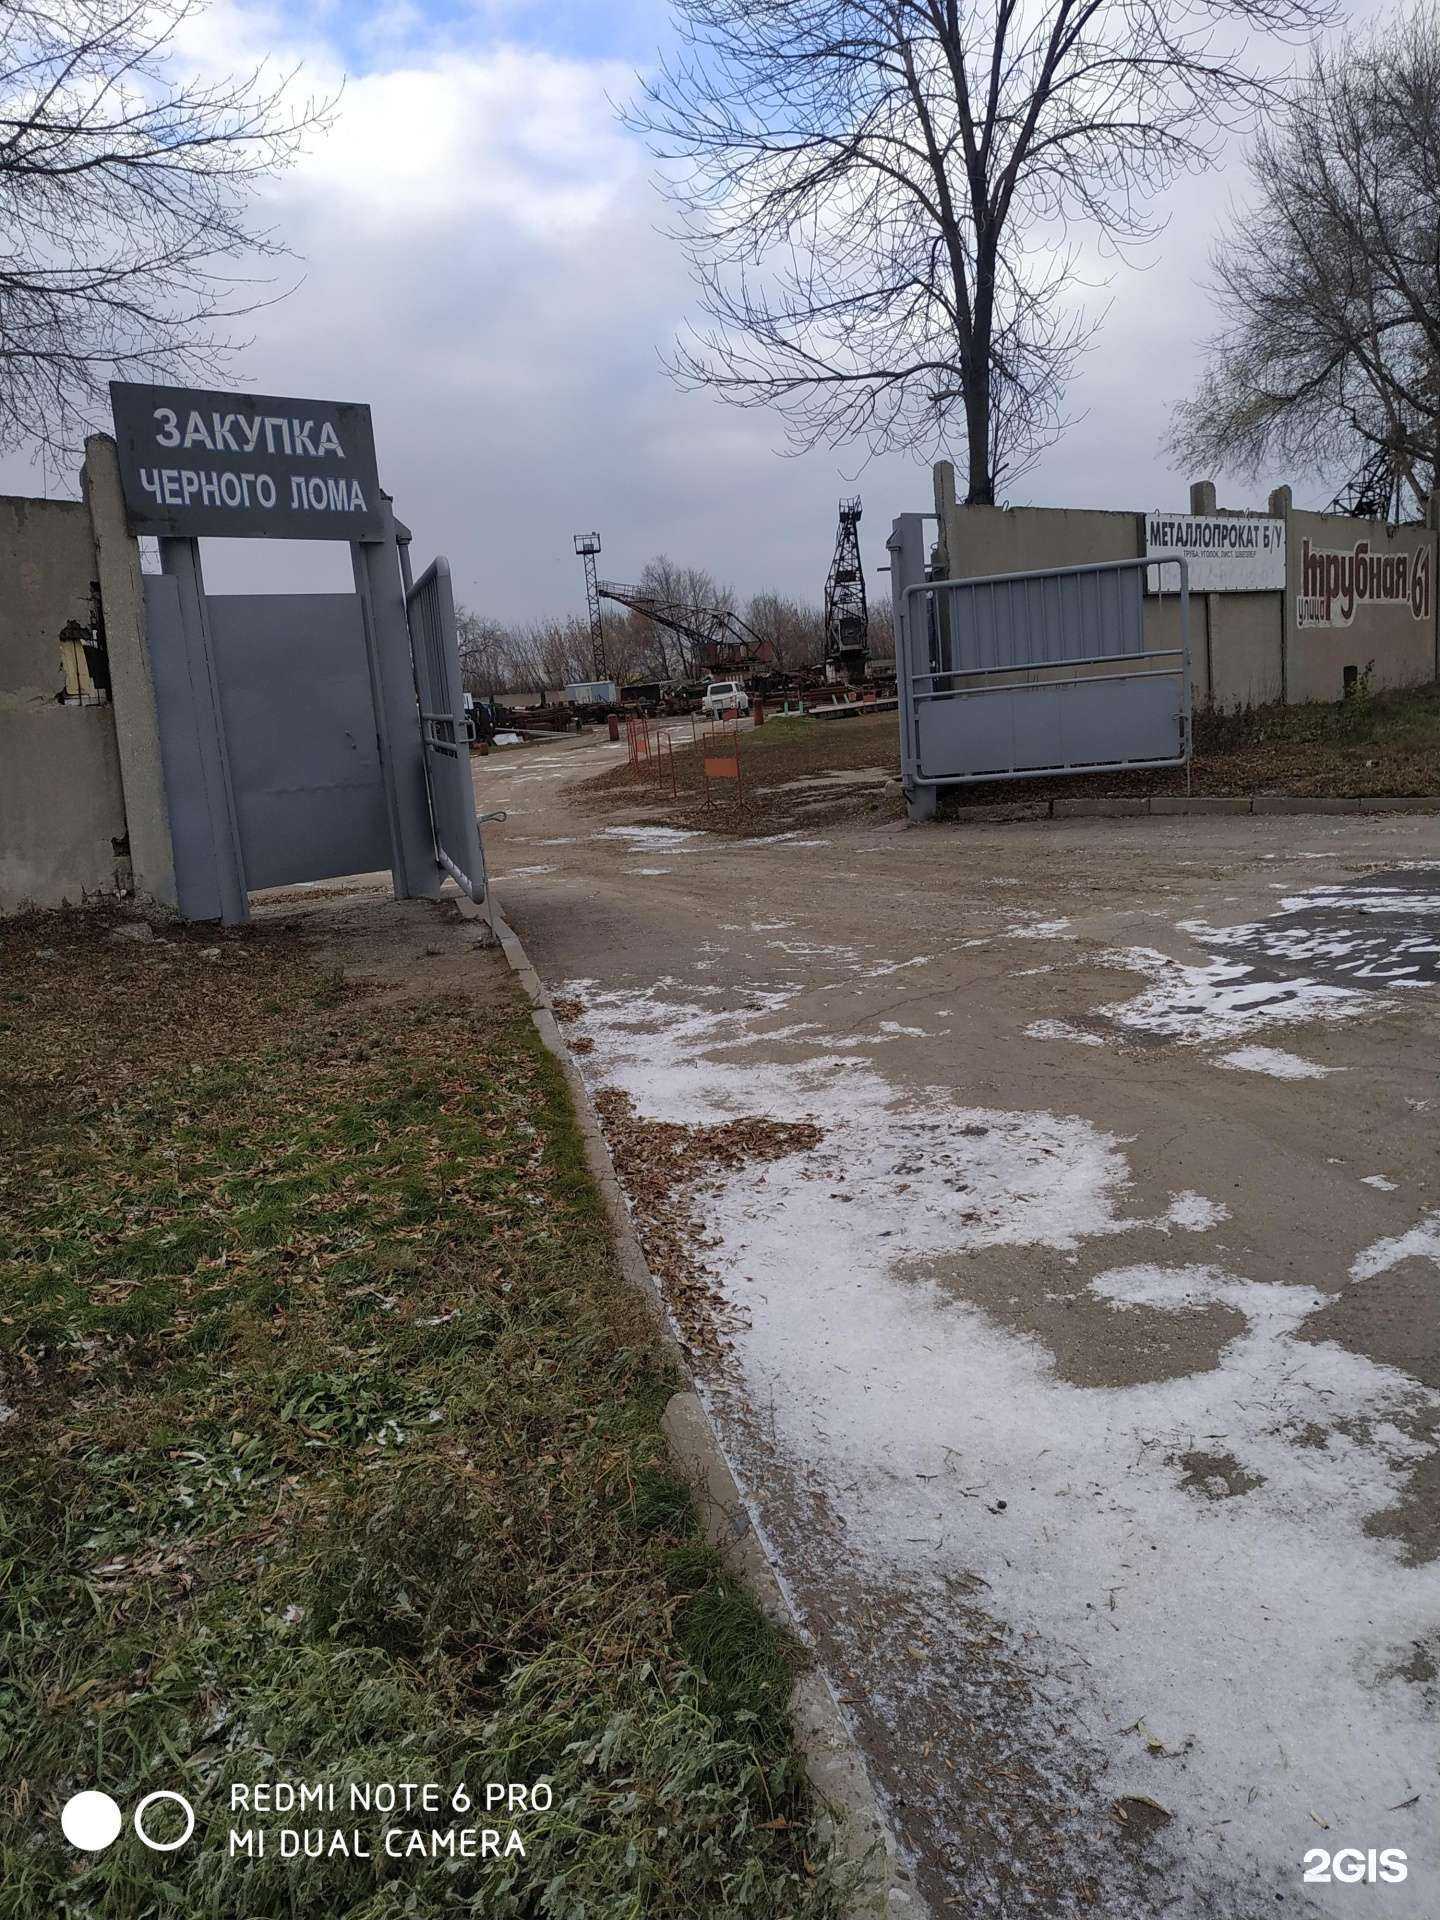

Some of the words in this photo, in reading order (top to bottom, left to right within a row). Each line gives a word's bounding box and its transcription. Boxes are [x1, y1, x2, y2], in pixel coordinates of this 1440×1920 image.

[153, 407, 346, 459] ЗАКУПКА
[139, 468, 277, 508] ЧЕРНОГО
[291, 476, 368, 513] ЛОМА
[1150, 521, 1260, 548] МЕТАЛЛОПРОКАТ
[1263, 525, 1282, 554] Б/У
[1411, 546, 1430, 618] 61
[1297, 598, 1327, 626] улица
